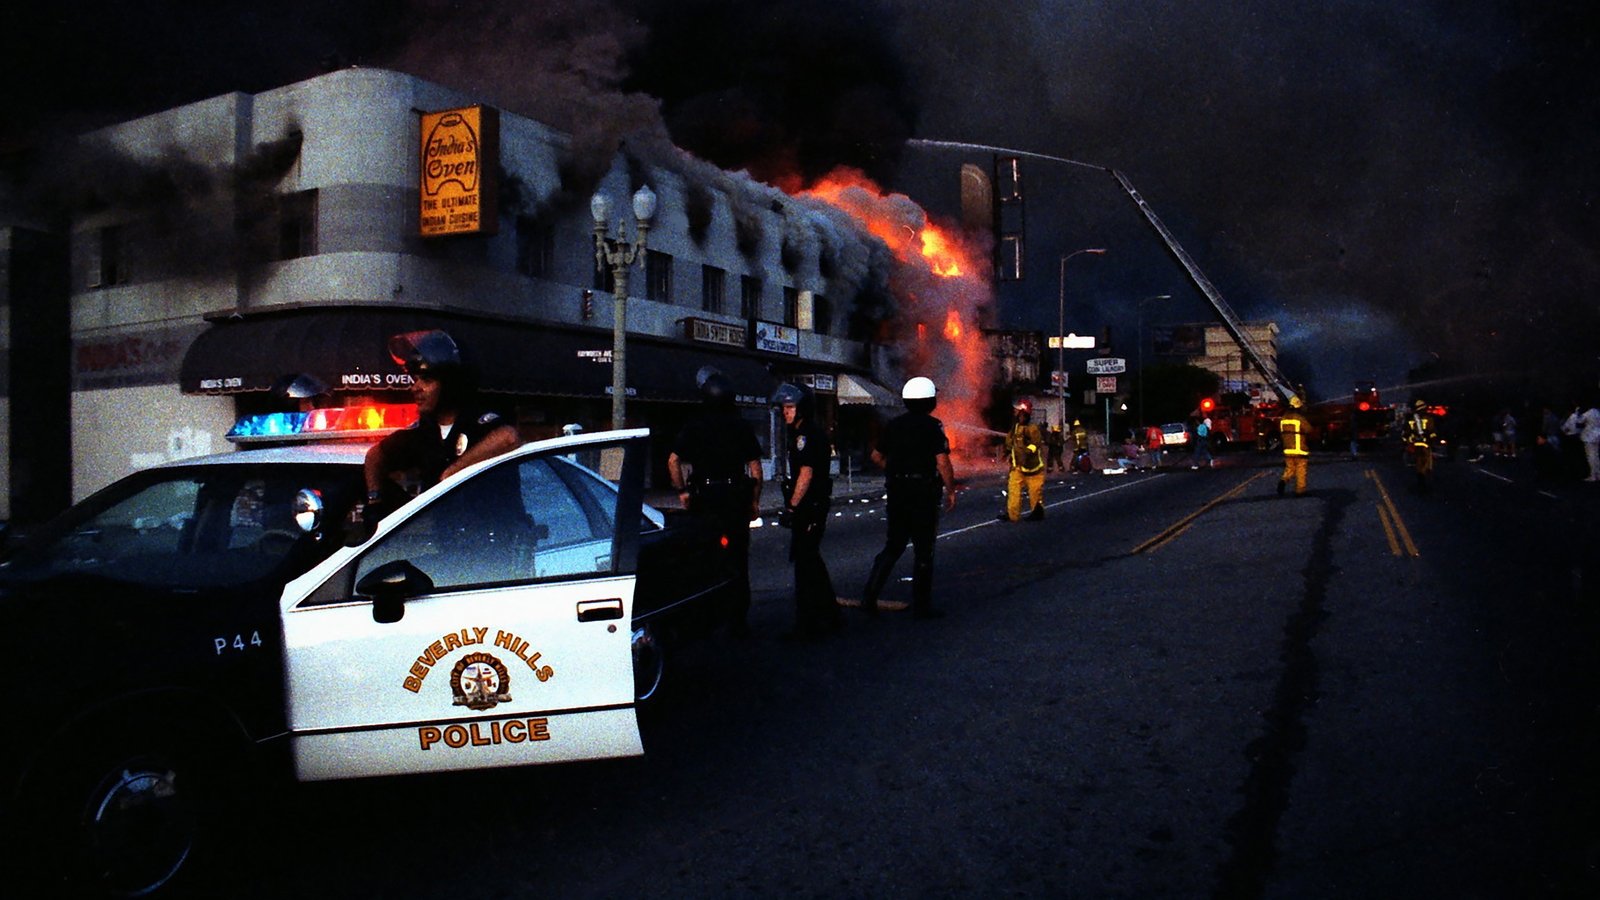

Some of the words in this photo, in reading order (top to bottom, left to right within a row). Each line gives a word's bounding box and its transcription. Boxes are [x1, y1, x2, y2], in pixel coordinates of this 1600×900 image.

[428, 134, 474, 158] India's
[428, 159, 475, 179] Oven
[424, 199, 438, 212] THE
[442, 194, 478, 209] ULTIMATE
[422, 215, 446, 227] INDIAN
[449, 212, 478, 225] CUISINE
[341, 374, 381, 385] INDIA'S
[403, 627, 488, 693] BEVERLY
[494, 630, 553, 682] HILLS
[419, 718, 551, 751] POLICE
